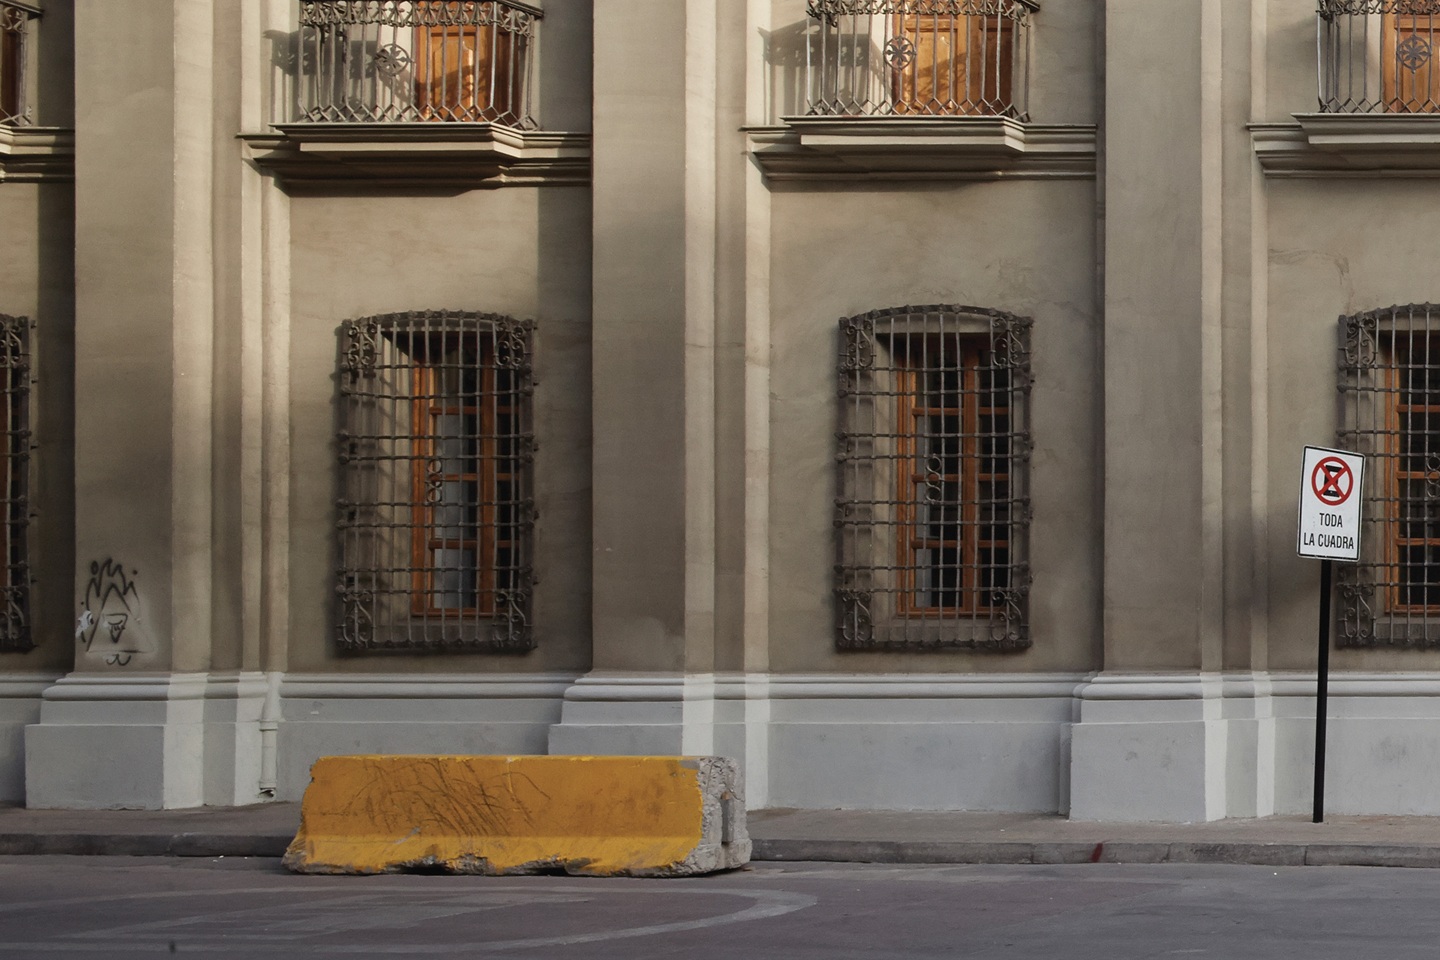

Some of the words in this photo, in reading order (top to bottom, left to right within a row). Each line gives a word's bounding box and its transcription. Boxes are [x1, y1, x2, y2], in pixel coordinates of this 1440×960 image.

[1319, 513, 1343, 528] TODA
[1303, 532, 1315, 546] LA
[1318, 533, 1354, 549] CUADRA
